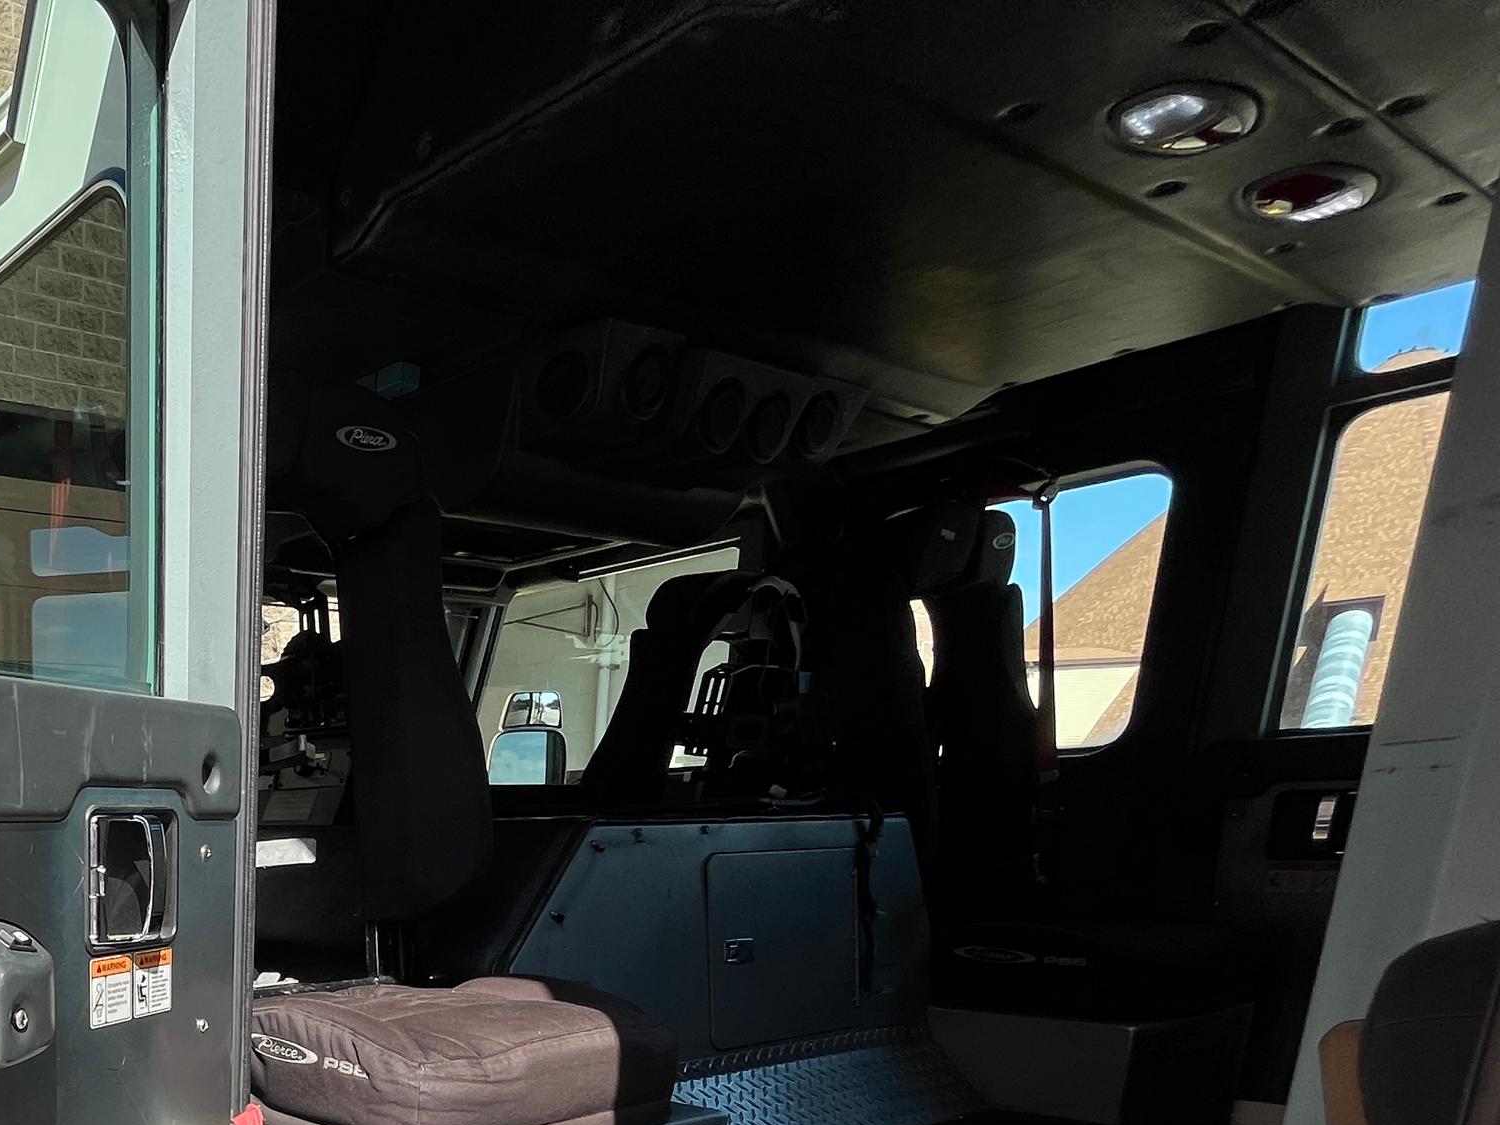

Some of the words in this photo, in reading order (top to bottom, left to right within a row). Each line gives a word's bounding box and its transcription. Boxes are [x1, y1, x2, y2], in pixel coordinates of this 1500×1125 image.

[144, 954, 167, 965] WARNING
[101, 961, 127, 972] WARNING
[258, 1037, 298, 1059] Pierce
